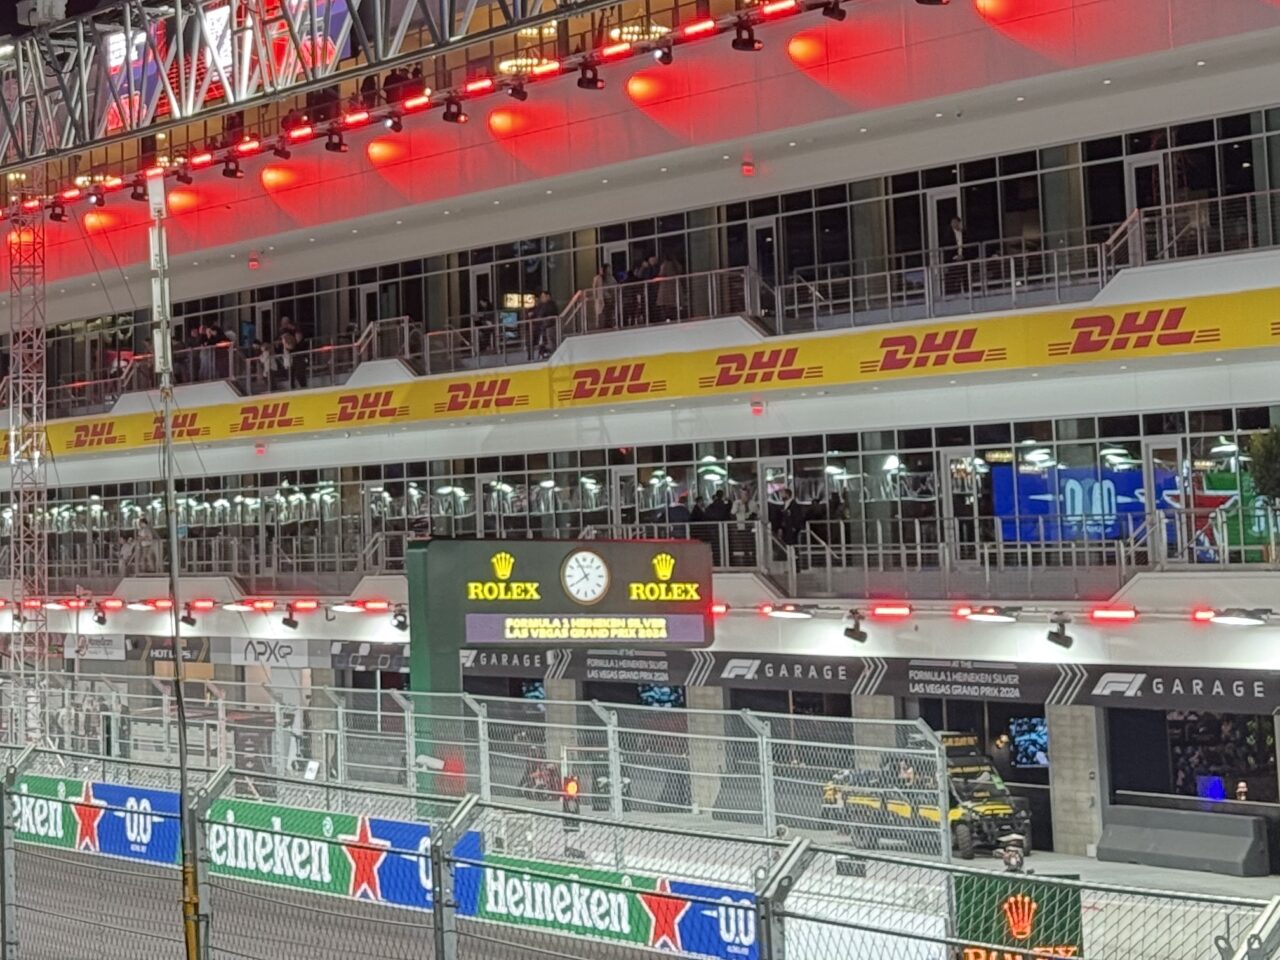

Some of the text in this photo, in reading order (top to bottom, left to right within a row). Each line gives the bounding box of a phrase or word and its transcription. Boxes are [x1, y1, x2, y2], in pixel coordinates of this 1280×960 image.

[1070, 307, 1195, 354] DHL
[879, 327, 985, 371] DHL
[715, 347, 805, 387] DHL
[447, 378, 516, 411] DHL
[572, 363, 651, 400] DHL
[240, 402, 294, 431] DHL
[337, 391, 397, 422] DHL
[74, 422, 117, 448] DHL
[152, 413, 201, 440] DHL
[467, 581, 541, 600] ROLEX
[629, 582, 701, 601] ROLEX
[505, 618, 561, 628] FORMULA
[570, 618, 626, 628] HEINEKEN
[627, 618, 666, 628] SILVER
[505, 627, 667, 638] LAS VEGAS GRAND PRIX 2024
[480, 652, 541, 668] GARAGE
[720, 658, 847, 680] F1 GARAGE
[909, 670, 946, 681] FORMULA
[952, 671, 992, 683] HEINEKEN
[993, 673, 1020, 684] SILVER
[909, 683, 1020, 697] LAS VEGAS GRAND PRIX 2024
[1091, 672, 1265, 698] F1 GARAGE
[125, 797, 152, 844] 0.0
[206, 809, 332, 884] eineken
[485, 867, 631, 934] Heineken
